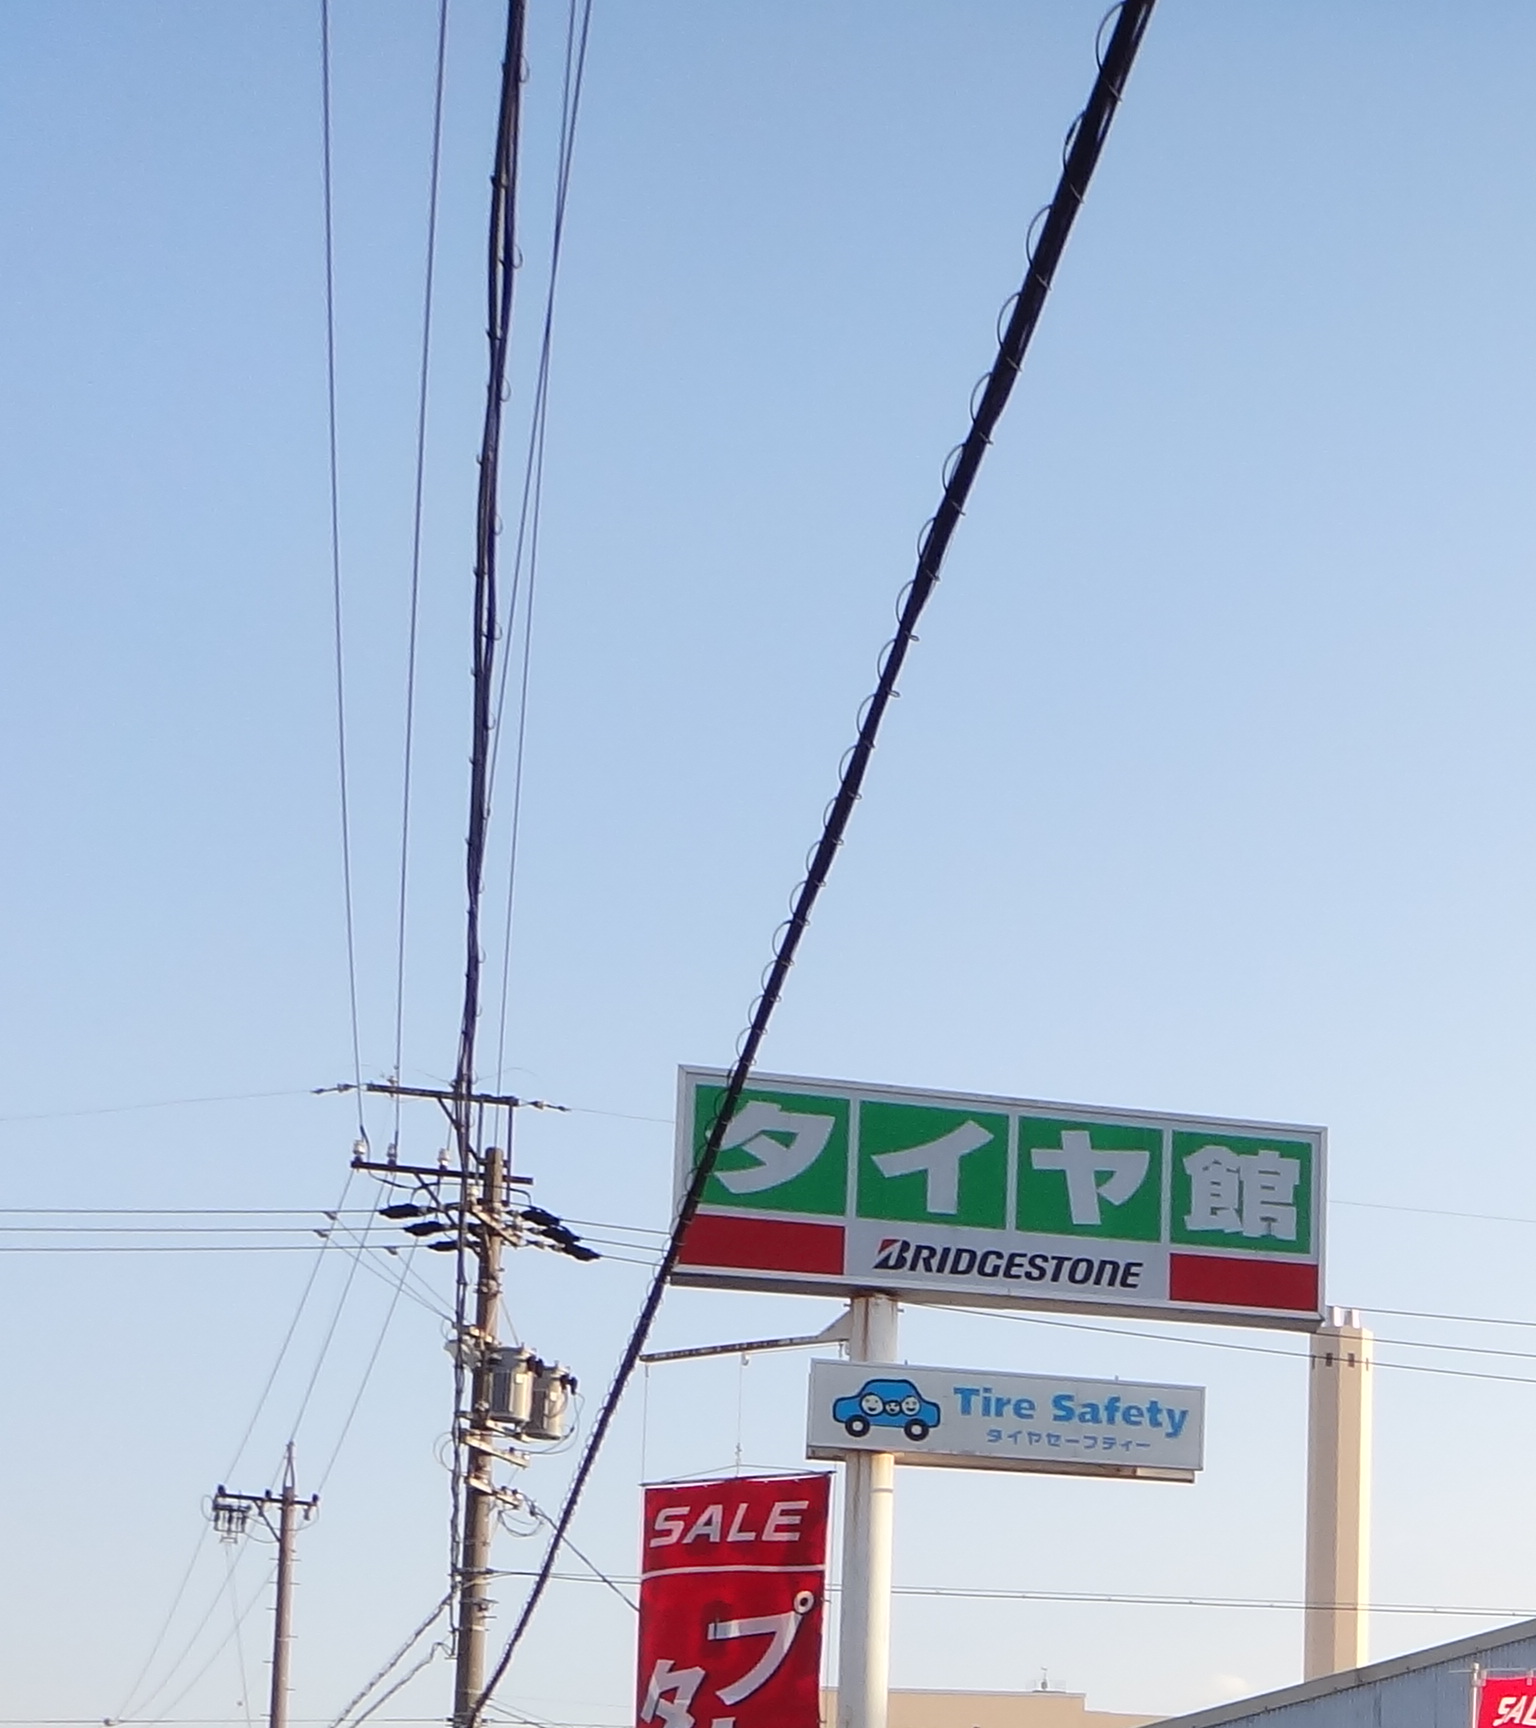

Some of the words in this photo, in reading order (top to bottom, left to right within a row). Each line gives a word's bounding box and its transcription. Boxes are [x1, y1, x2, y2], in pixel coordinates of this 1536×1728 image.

[707, 1100, 1298, 1241] タイヤ館
[873, 1238, 1143, 1289] BRIDGESTONE
[953, 1386, 1036, 1421] Tire
[1052, 1393, 1189, 1438] Safety
[987, 1428, 1151, 1452] タイヤセーフティー
[649, 1500, 808, 1548] SALE
